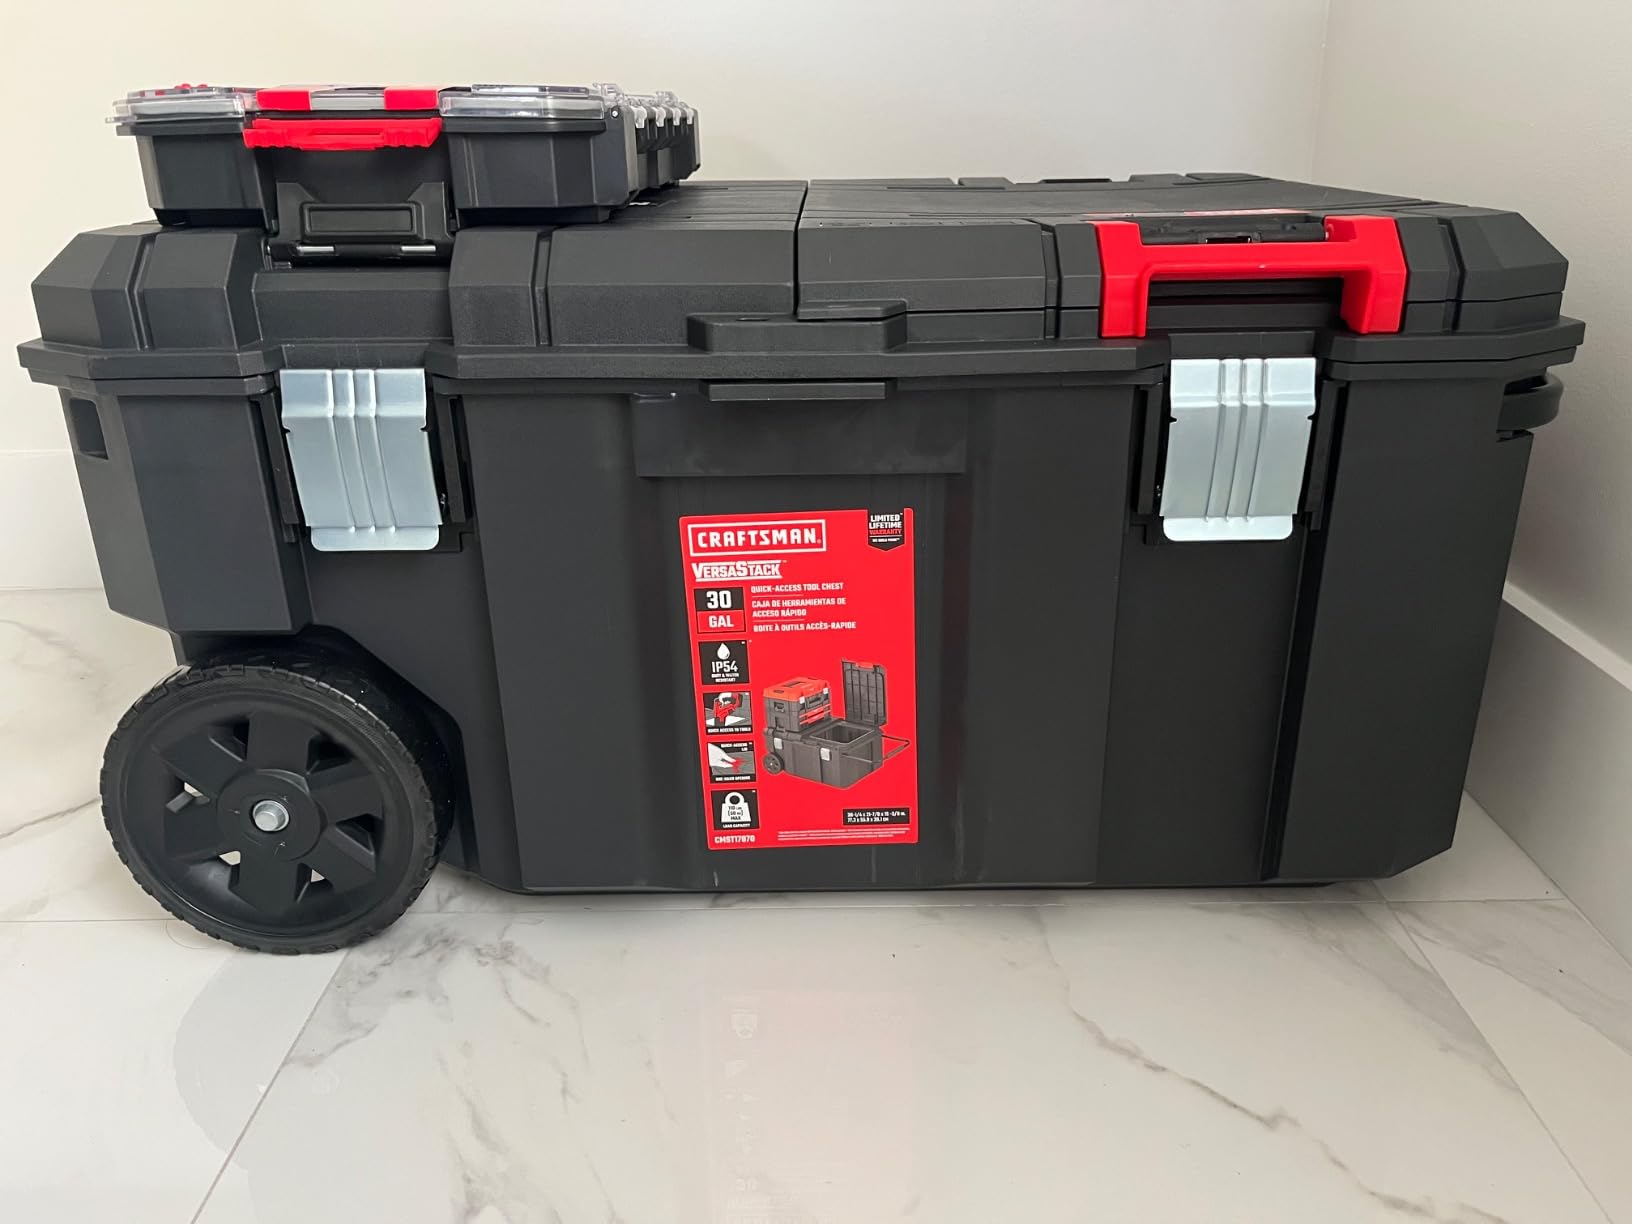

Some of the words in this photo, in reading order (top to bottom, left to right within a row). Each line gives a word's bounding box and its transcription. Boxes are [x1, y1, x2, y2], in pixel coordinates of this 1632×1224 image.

[870, 514, 900, 522] LIMITED
[869, 521, 902, 529] LIFETIME
[697, 528, 816, 548] CRAFTSMAN
[750, 584, 802, 593] QUICK-ACCESS
[803, 583, 820, 591] TOOL
[821, 582, 844, 590] CHEST
[706, 590, 732, 609] 30
[751, 600, 770, 608] CAJA
[782, 598, 836, 607] HERRAMIENTAS
[837, 597, 846, 605] DE
[781, 608, 807, 616] RÁPIDO
[708, 615, 734, 628] GAL
[781, 623, 805, 631] OUTILS
[806, 621, 857, 630] ACCÈS-RAPIDE
[711, 660, 738, 673] IP54
